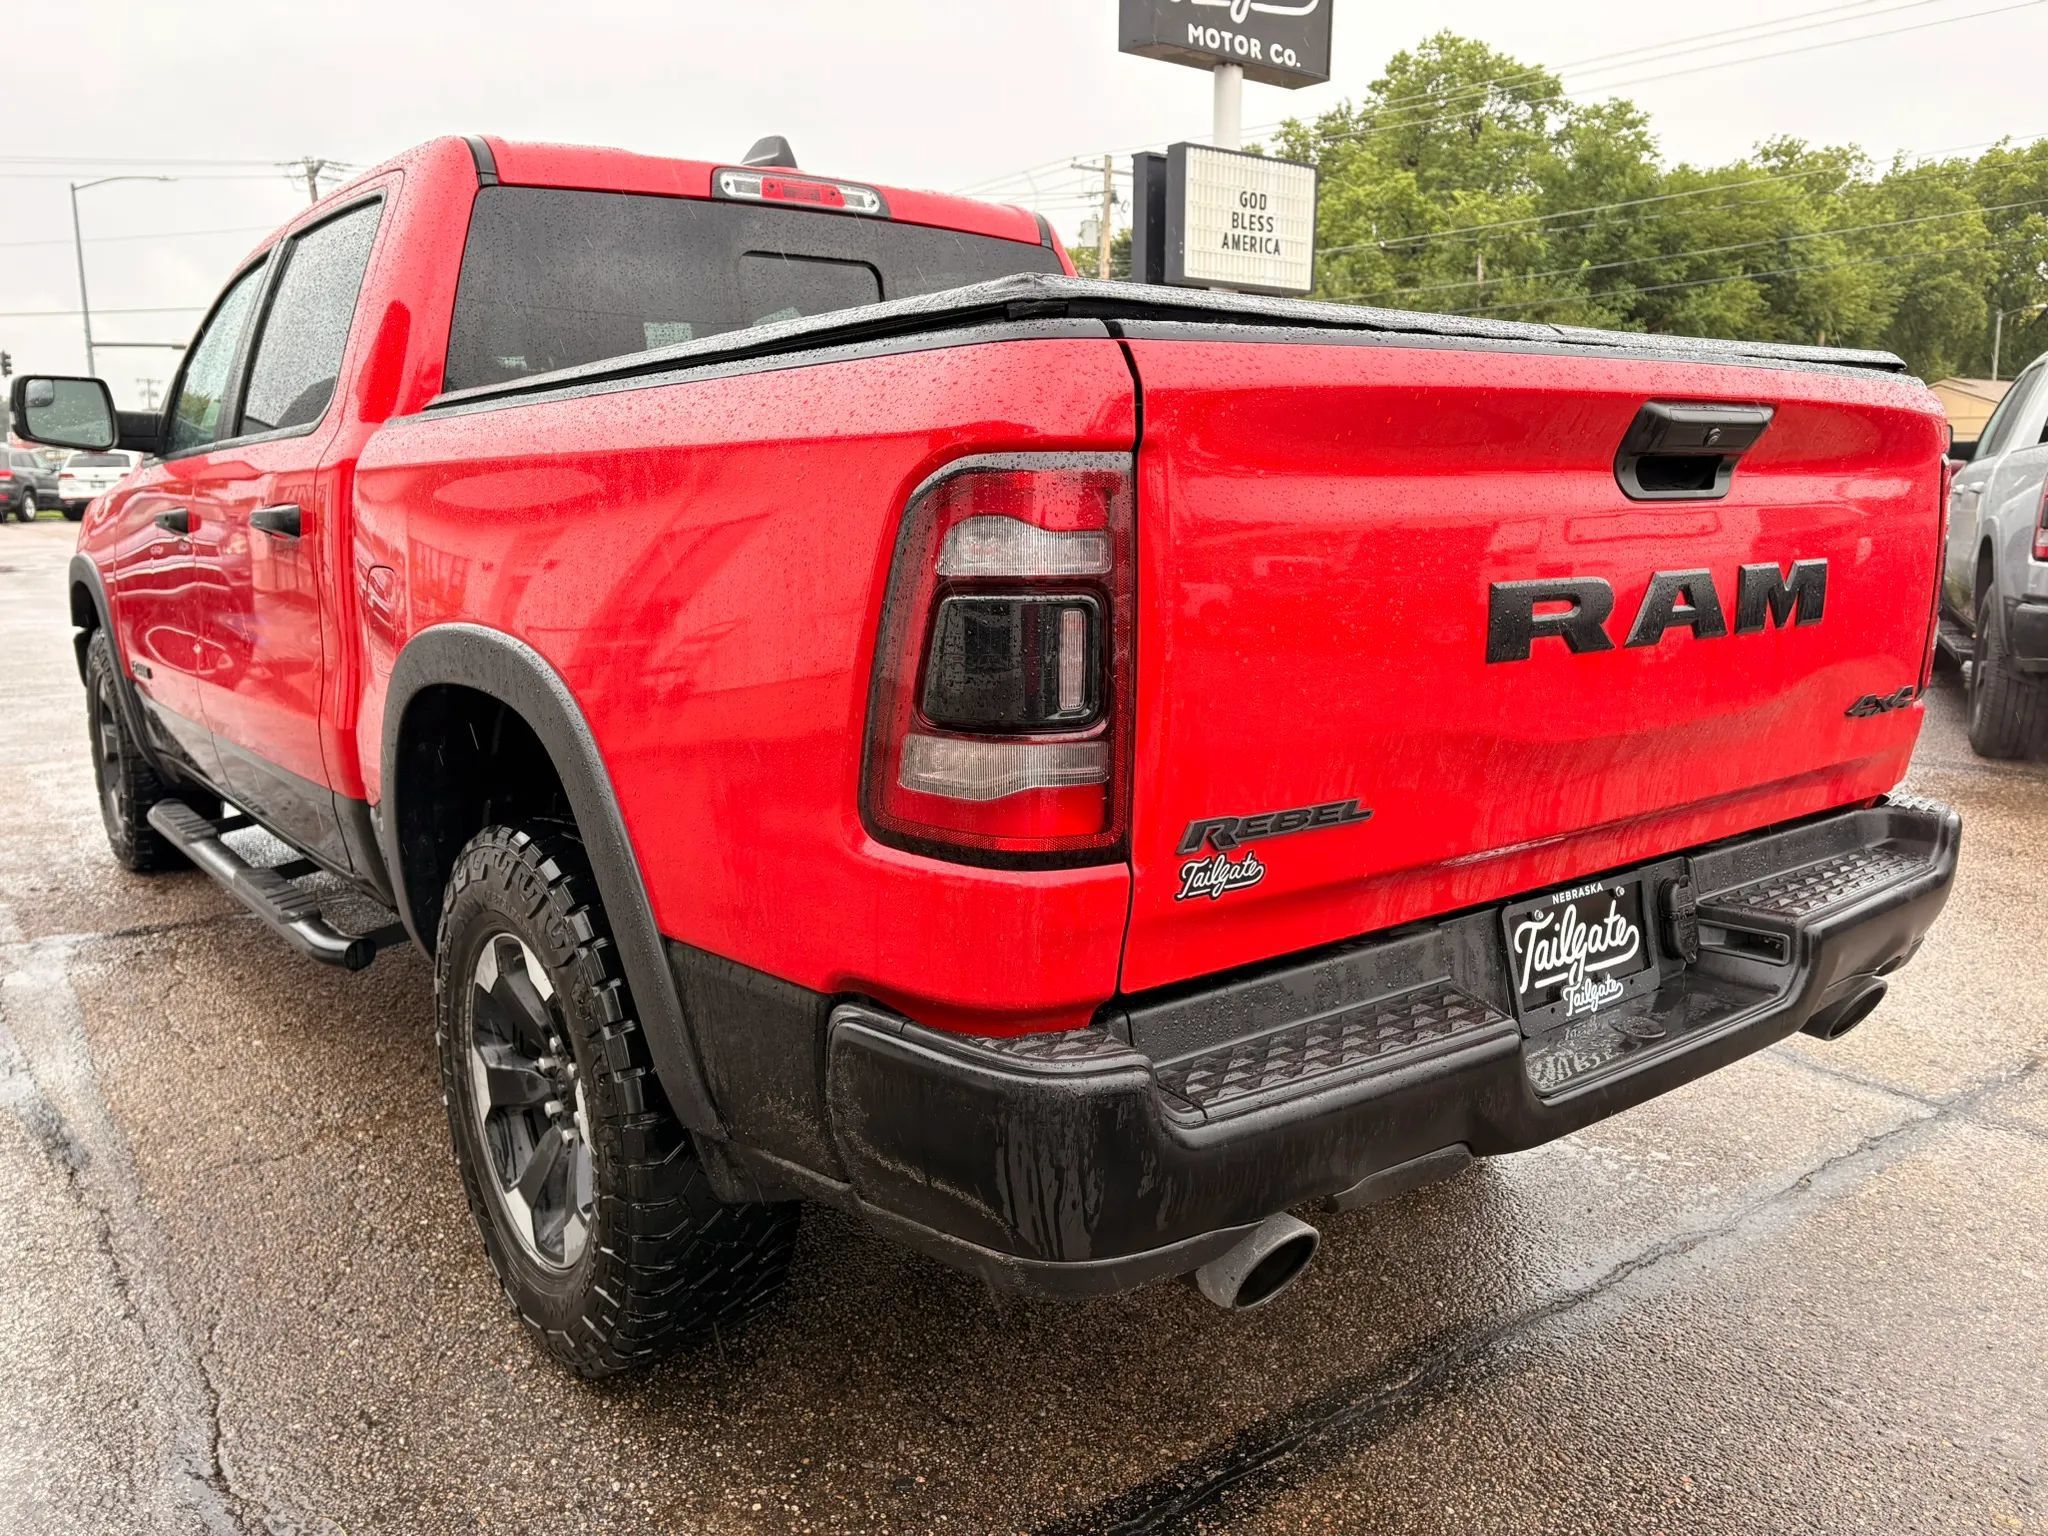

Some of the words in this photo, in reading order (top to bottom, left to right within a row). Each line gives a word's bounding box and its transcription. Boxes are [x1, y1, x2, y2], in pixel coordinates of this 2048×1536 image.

[1188, 23, 1262, 60] MOTOR
[1269, 43, 1301, 67] CO.
[1231, 211, 1274, 233] BLESS
[1239, 190, 1267, 211] GOD
[1221, 232, 1281, 256] AMERICA
[1485, 557, 1828, 664] RAM
[1175, 797, 1374, 856] REBEL
[1175, 851, 1265, 900] Tailgate
[1552, 882, 1604, 905] NEBRASKA
[1513, 899, 1640, 994] Tailgate
[1562, 973, 1624, 1017] Tailgate
